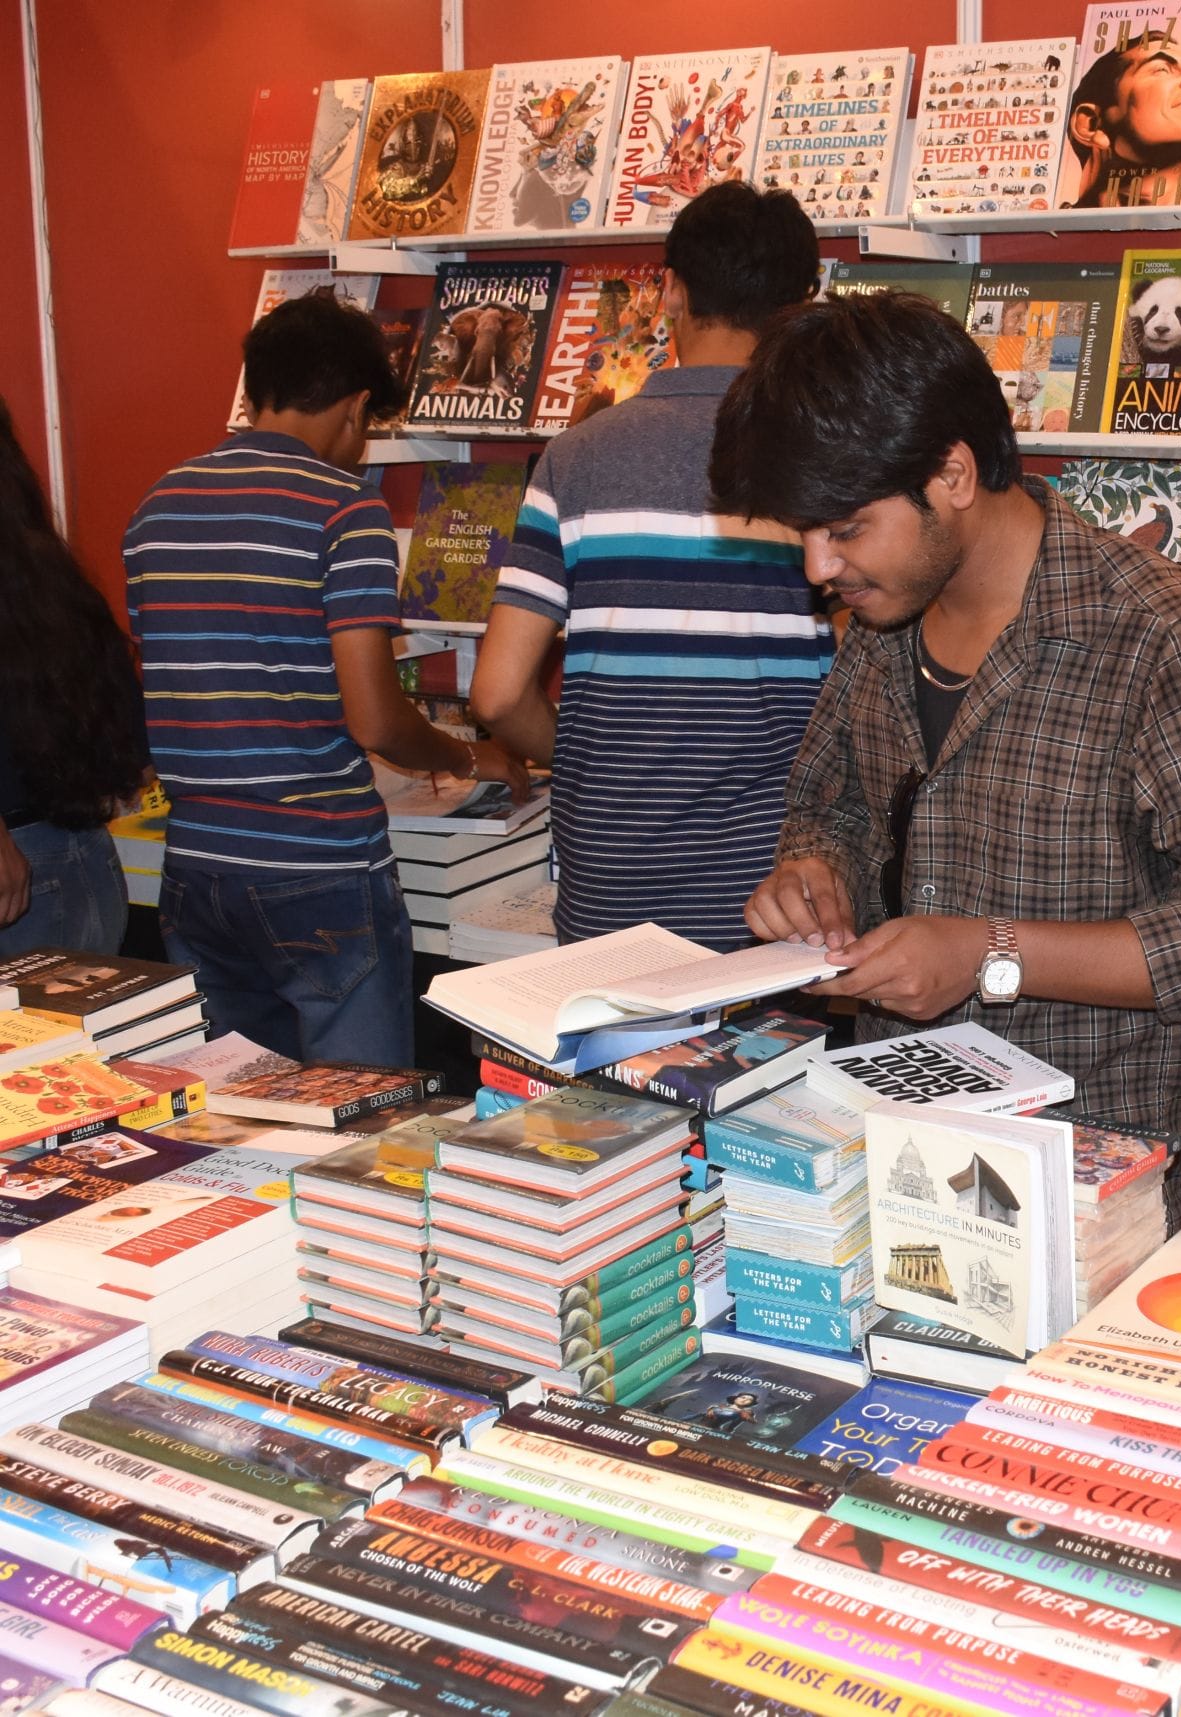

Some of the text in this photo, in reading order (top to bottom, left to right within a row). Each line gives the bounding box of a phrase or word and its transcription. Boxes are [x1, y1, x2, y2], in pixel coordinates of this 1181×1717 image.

[1100, 10, 1130, 19] PAUL
[1136, 7, 1165, 17] DINI
[371, 90, 475, 142] EXPLANATORIUM
[784, 100, 878, 118] TIMELINES
[938, 109, 1041, 128] TIMELINES
[819, 120, 837, 132] OF
[973, 129, 998, 144] OF
[474, 79, 516, 230] KNOWLEDGE
[614, 74, 658, 226] HUMAN BODY!
[766, 134, 887, 152] EXTRAORDINARY
[922, 144, 1049, 164] EVERYTHING
[248, 150, 308, 165] HISTORY
[803, 154, 844, 167] LIVES
[1109, 168, 1158, 177] POWER
[362, 184, 457, 231] HISTORY
[440, 277, 549, 308] SUPERFACTS
[977, 283, 1029, 297] battles
[534, 281, 600, 429] PLANET EARTH!
[415, 398, 523, 421] ANIMALS
[452, 509, 468, 520] The
[449, 525, 492, 535] ENGLISH
[426, 538, 491, 550] GARDENER'S
[444, 553, 487, 564] GARDEN
[870, 1052, 961, 1098] GOOD
[890, 1039, 1005, 1094] ADVICE
[338, 1086, 413, 1118] GODS GODDESSES
[1016, 1093, 1047, 1107] George Lois
[722, 1143, 776, 1163] LETTERS FOR
[731, 1153, 771, 1169] THE YEAR
[159, 1173, 251, 1195] Colds & Flu
[878, 1199, 1021, 1249] ARCHITECTURE IN MINUTES
[627, 1243, 672, 1276] cocktails
[893, 1321, 973, 1343] CLAUDIA
[201, 1335, 330, 1377] NORA ROBERTS
[1077, 1349, 1105, 1359] NO
[1028, 1371, 1067, 1386] How
[1070, 1380, 1091, 1390] To
[1065, 1358, 1167, 1384] HONEST
[341, 1374, 447, 1407] LEGACY
[713, 1369, 817, 1401] MIRRORVERSE
[529, 1409, 649, 1447] MICHAEL CONNELLY
[982, 1431, 1059, 1460] LEADING
[1062, 1446, 1102, 1469] FROM
[1109, 1435, 1156, 1455] KISS
[4, 1462, 131, 1511] STEVE BERRY
[505, 1467, 756, 1542] AROUND THE WORLD IN EIGHTY GAMES
[369, 1531, 503, 1584] AMBESSA
[360, 1549, 484, 1592] CHOSEN OF THE WOLF
[154, 1633, 318, 1694] SIMON MASON
[746, 1651, 902, 1713] DENISE MINA
